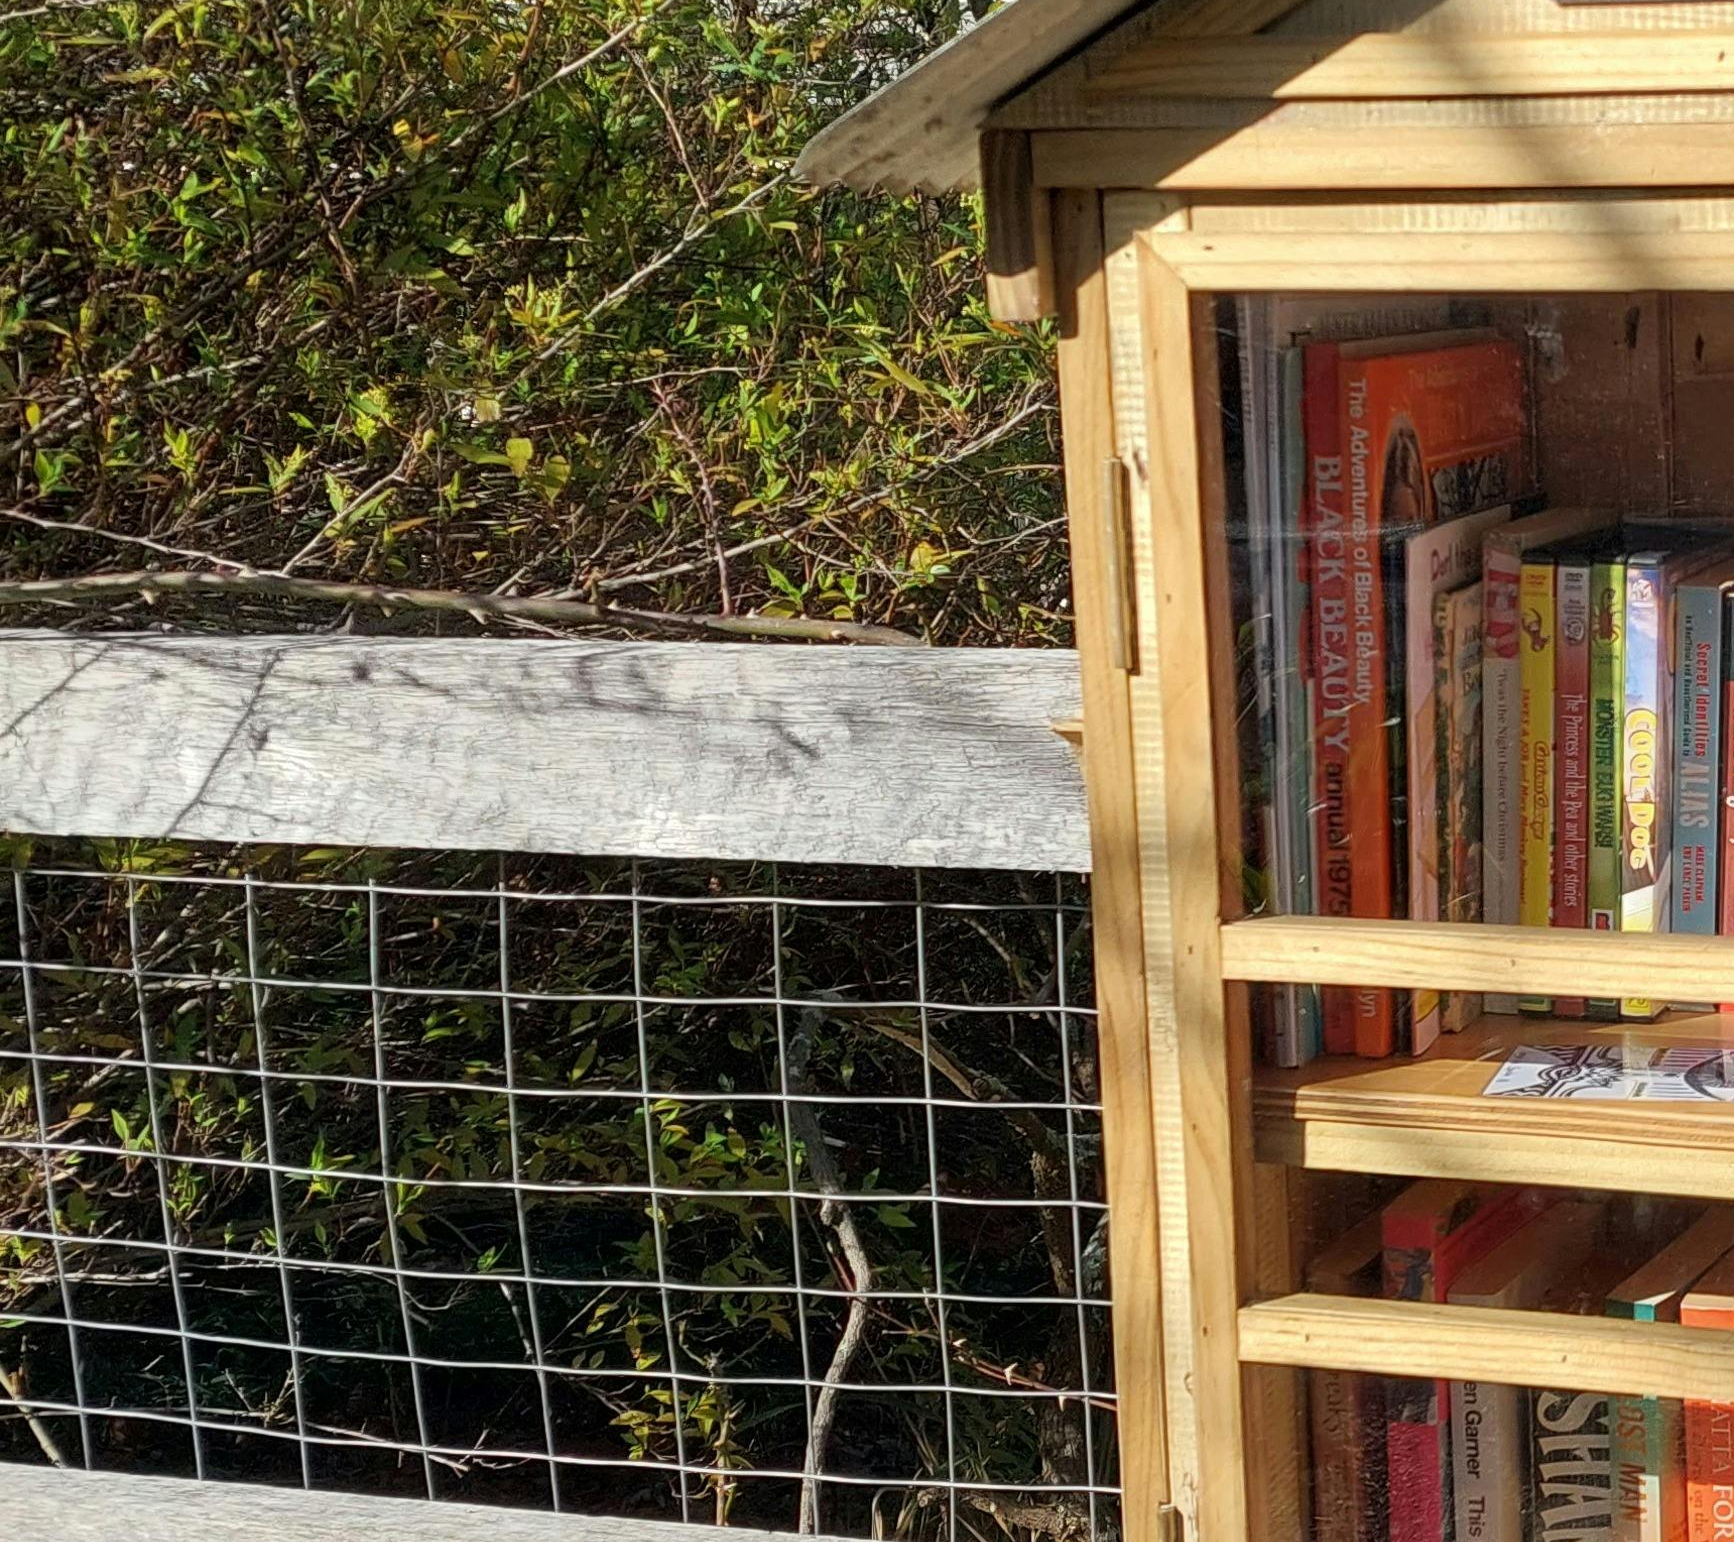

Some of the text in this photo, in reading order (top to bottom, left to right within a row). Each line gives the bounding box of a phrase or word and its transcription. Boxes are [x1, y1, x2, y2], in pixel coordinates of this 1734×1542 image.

[1313, 455, 1346, 584] BLACK
[1347, 379, 1376, 703] The Adventures of Black Beauty
[1315, 597, 1351, 755] BEAUTY
[1694, 642, 1712, 757] Secret Identities
[1594, 698, 1615, 765] MONSTER
[1324, 761, 1352, 851] annual
[1559, 693, 1587, 907] The Princess and the Pea and other stories
[1624, 708, 1659, 871] COOL DOG
[1679, 760, 1711, 828] ALIAS
[1463, 1420, 1484, 1479] Garner
[1619, 1462, 1649, 1523] MAN
[1468, 1496, 1487, 1538] This
